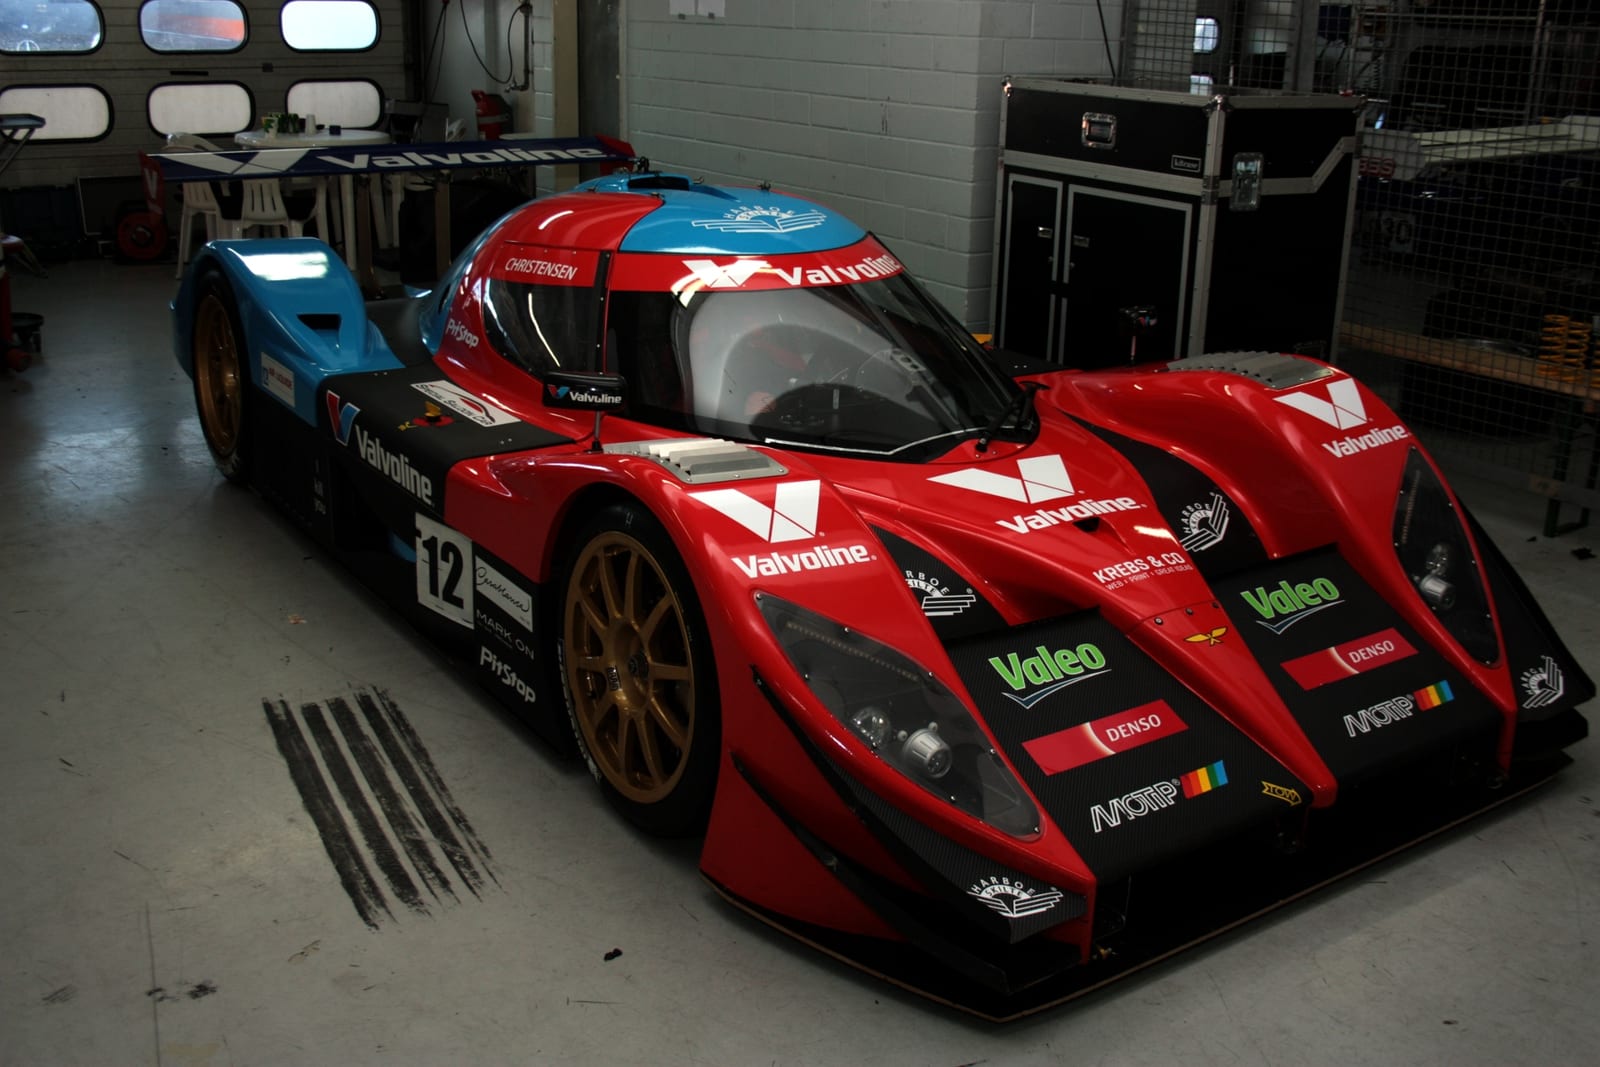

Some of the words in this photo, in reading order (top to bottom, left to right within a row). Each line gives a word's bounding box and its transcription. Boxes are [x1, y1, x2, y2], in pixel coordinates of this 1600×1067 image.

[315, 147, 607, 170] Valvoline
[505, 257, 578, 281] CHRISTENSEN
[776, 254, 902, 286] Valvoline
[569, 391, 623, 404] Valvoline
[1321, 425, 1410, 459] Valvoline
[355, 424, 433, 506] Valvoline
[995, 497, 1142, 534] Valvoline
[422, 536, 464, 609] 12
[731, 545, 874, 579] Valvoline
[1093, 558, 1150, 584] KREBS
[1146, 555, 1164, 568] &
[1161, 552, 1186, 566] CO
[905, 570, 951, 595] RBOE
[1240, 577, 1340, 620] Valeo
[476, 608, 512, 643] MARK
[987, 643, 1106, 692] Valeo
[1348, 640, 1396, 664] DENSO
[479, 645, 537, 704] PitStop
[1105, 713, 1163, 743] DENSO
[1269, 785, 1298, 801] TOW
[971, 876, 1037, 896] HARBOE
